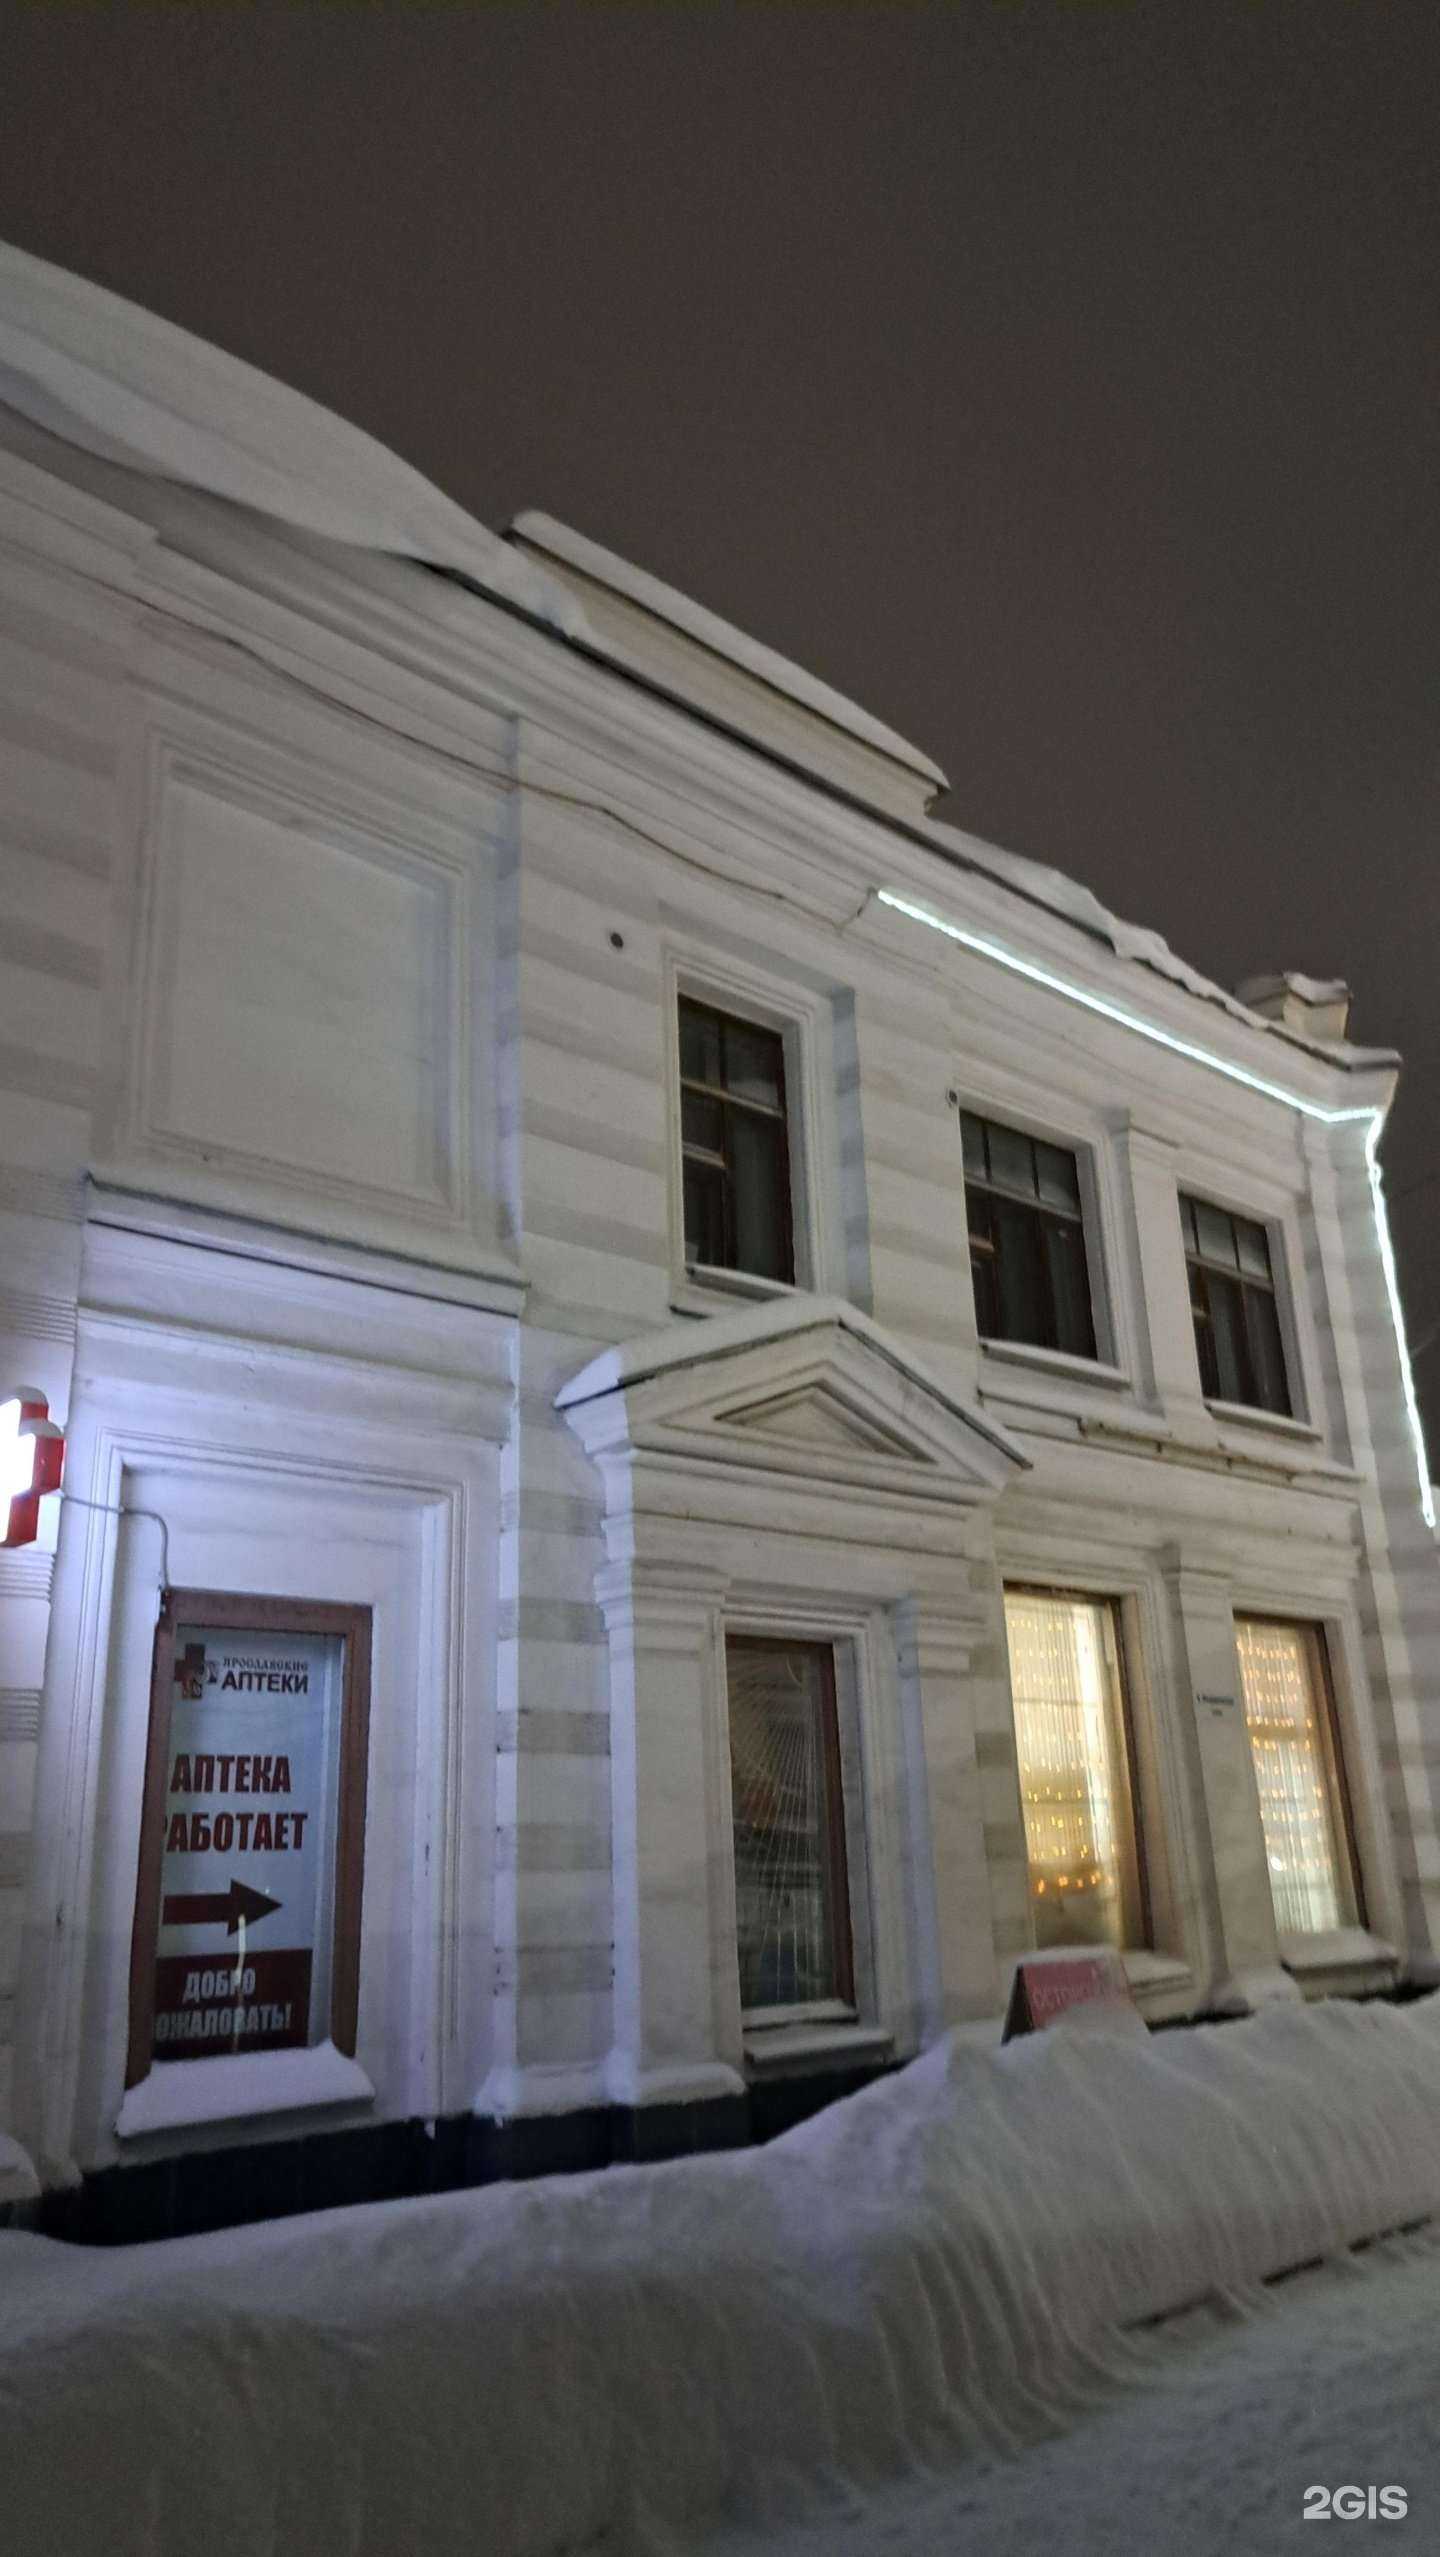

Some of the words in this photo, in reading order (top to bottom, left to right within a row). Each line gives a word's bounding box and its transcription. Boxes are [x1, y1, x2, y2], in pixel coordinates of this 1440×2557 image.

[221, 1671, 309, 1694] АПТЕКИ
[170, 1753, 292, 1794] АПТЕКА
[164, 1812, 309, 1852] АБОТАЕТ
[182, 1967, 257, 2004] ДОБРО
[155, 2002, 292, 2042] ОЖАЛОВАТЬ!
